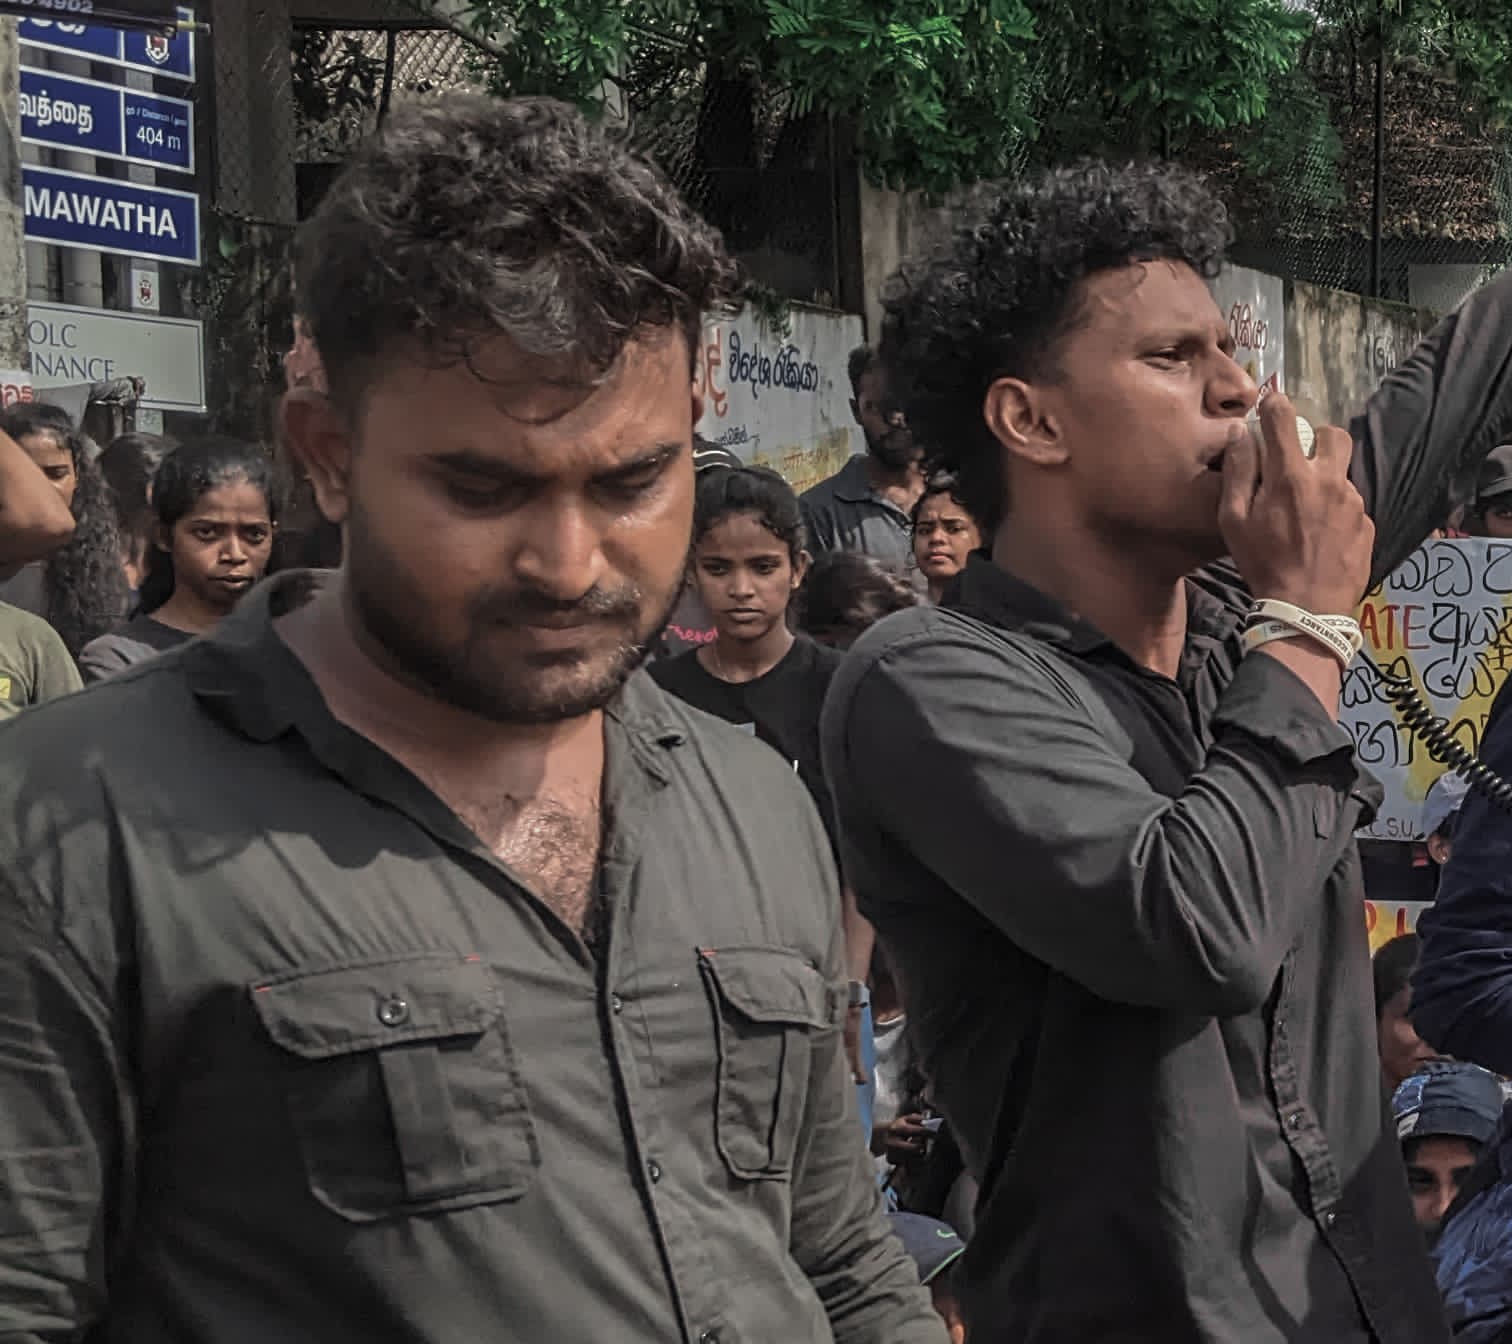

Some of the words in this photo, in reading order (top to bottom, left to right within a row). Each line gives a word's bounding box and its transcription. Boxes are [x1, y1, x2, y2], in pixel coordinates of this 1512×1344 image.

[136, 125, 164, 147] 404
[168, 135, 181, 150] m
[25, 185, 178, 239] MAWATHA
[28, 320, 77, 349] OLC
